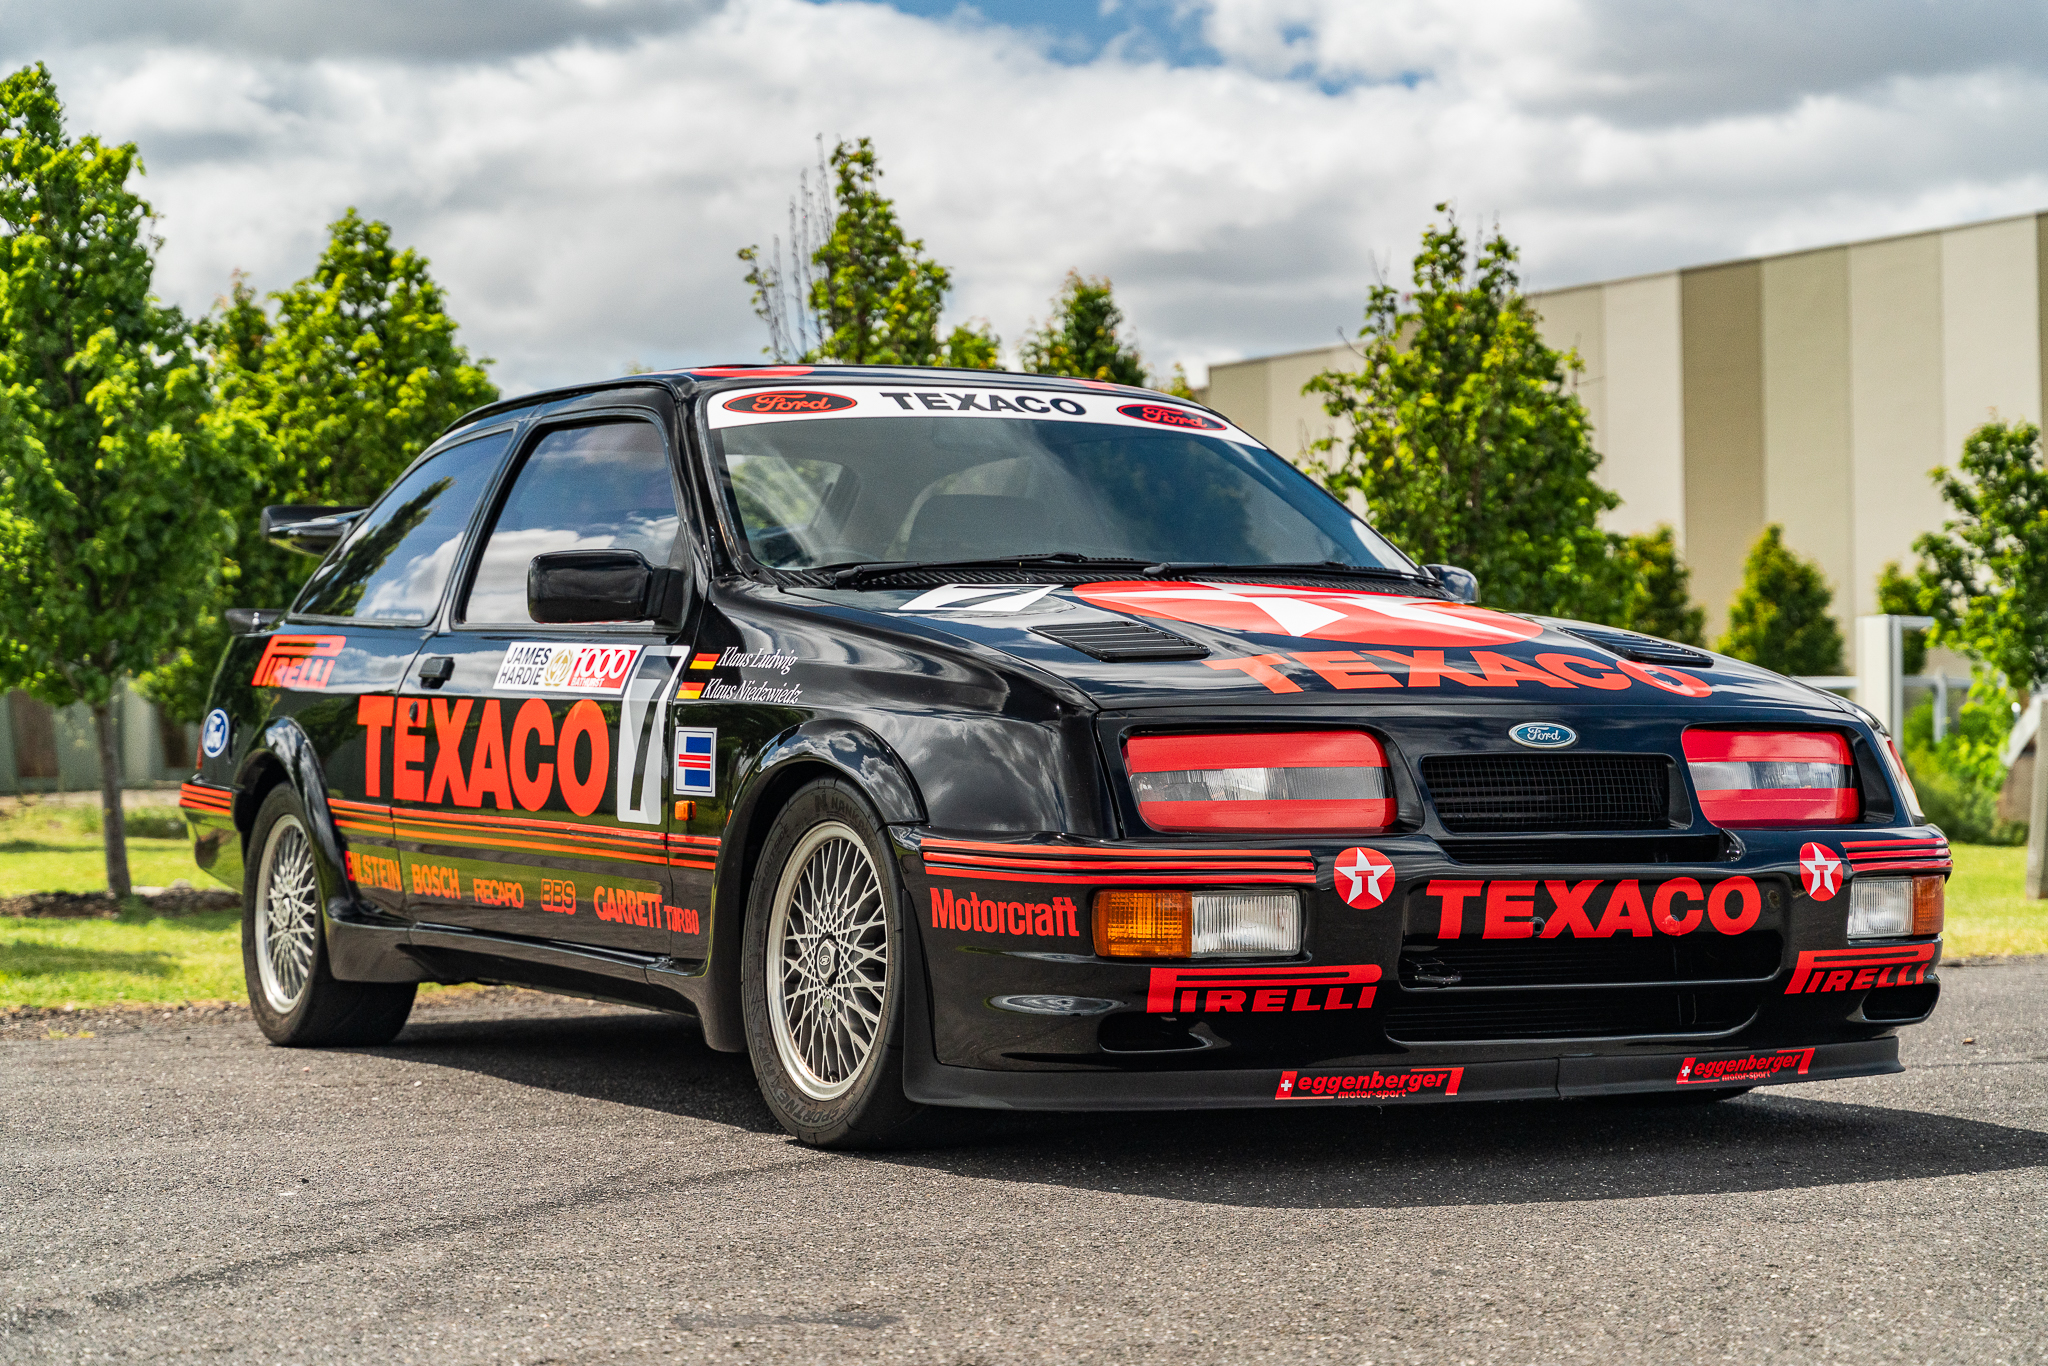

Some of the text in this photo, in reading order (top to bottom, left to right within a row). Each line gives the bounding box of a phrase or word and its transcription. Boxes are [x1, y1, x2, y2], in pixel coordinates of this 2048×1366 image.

[751, 393, 832, 412] Ford
[879, 391, 1087, 416] TEXACO
[1142, 406, 1208, 428] Ford
[251, 634, 347, 690] PIRELLI
[507, 646, 552, 665] JAMES
[573, 648, 631, 680] 1000
[716, 646, 799, 676] Klaus Ludwig
[498, 666, 545, 686] HARDIE
[570, 677, 605, 688] BATHURST
[1201, 649, 1713, 698] TEXACO
[701, 678, 803, 705] Klaus Niedzwiedz
[630, 655, 683, 812] 7
[1526, 726, 1561, 741] Ford
[357, 695, 610, 818] TEXACO
[345, 850, 402, 892] BILSTEIN
[411, 863, 462, 900] BOSCH
[473, 877, 525, 909] RECARO
[540, 877, 577, 915] BBS
[1426, 876, 1762, 940] TEXACO
[593, 885, 701, 936] GARRETT TURBO
[929, 887, 1080, 937] Motorcraft
[1784, 943, 1936, 995] PIRELLI
[1146, 964, 1384, 1014] PIRELLI
[1297, 1070, 1448, 1095] eggenberger
[1694, 1054, 1802, 1079] eggenberger
[1721, 1070, 1771, 1082] motor-sport
[1337, 1088, 1407, 1100] motor-sport
